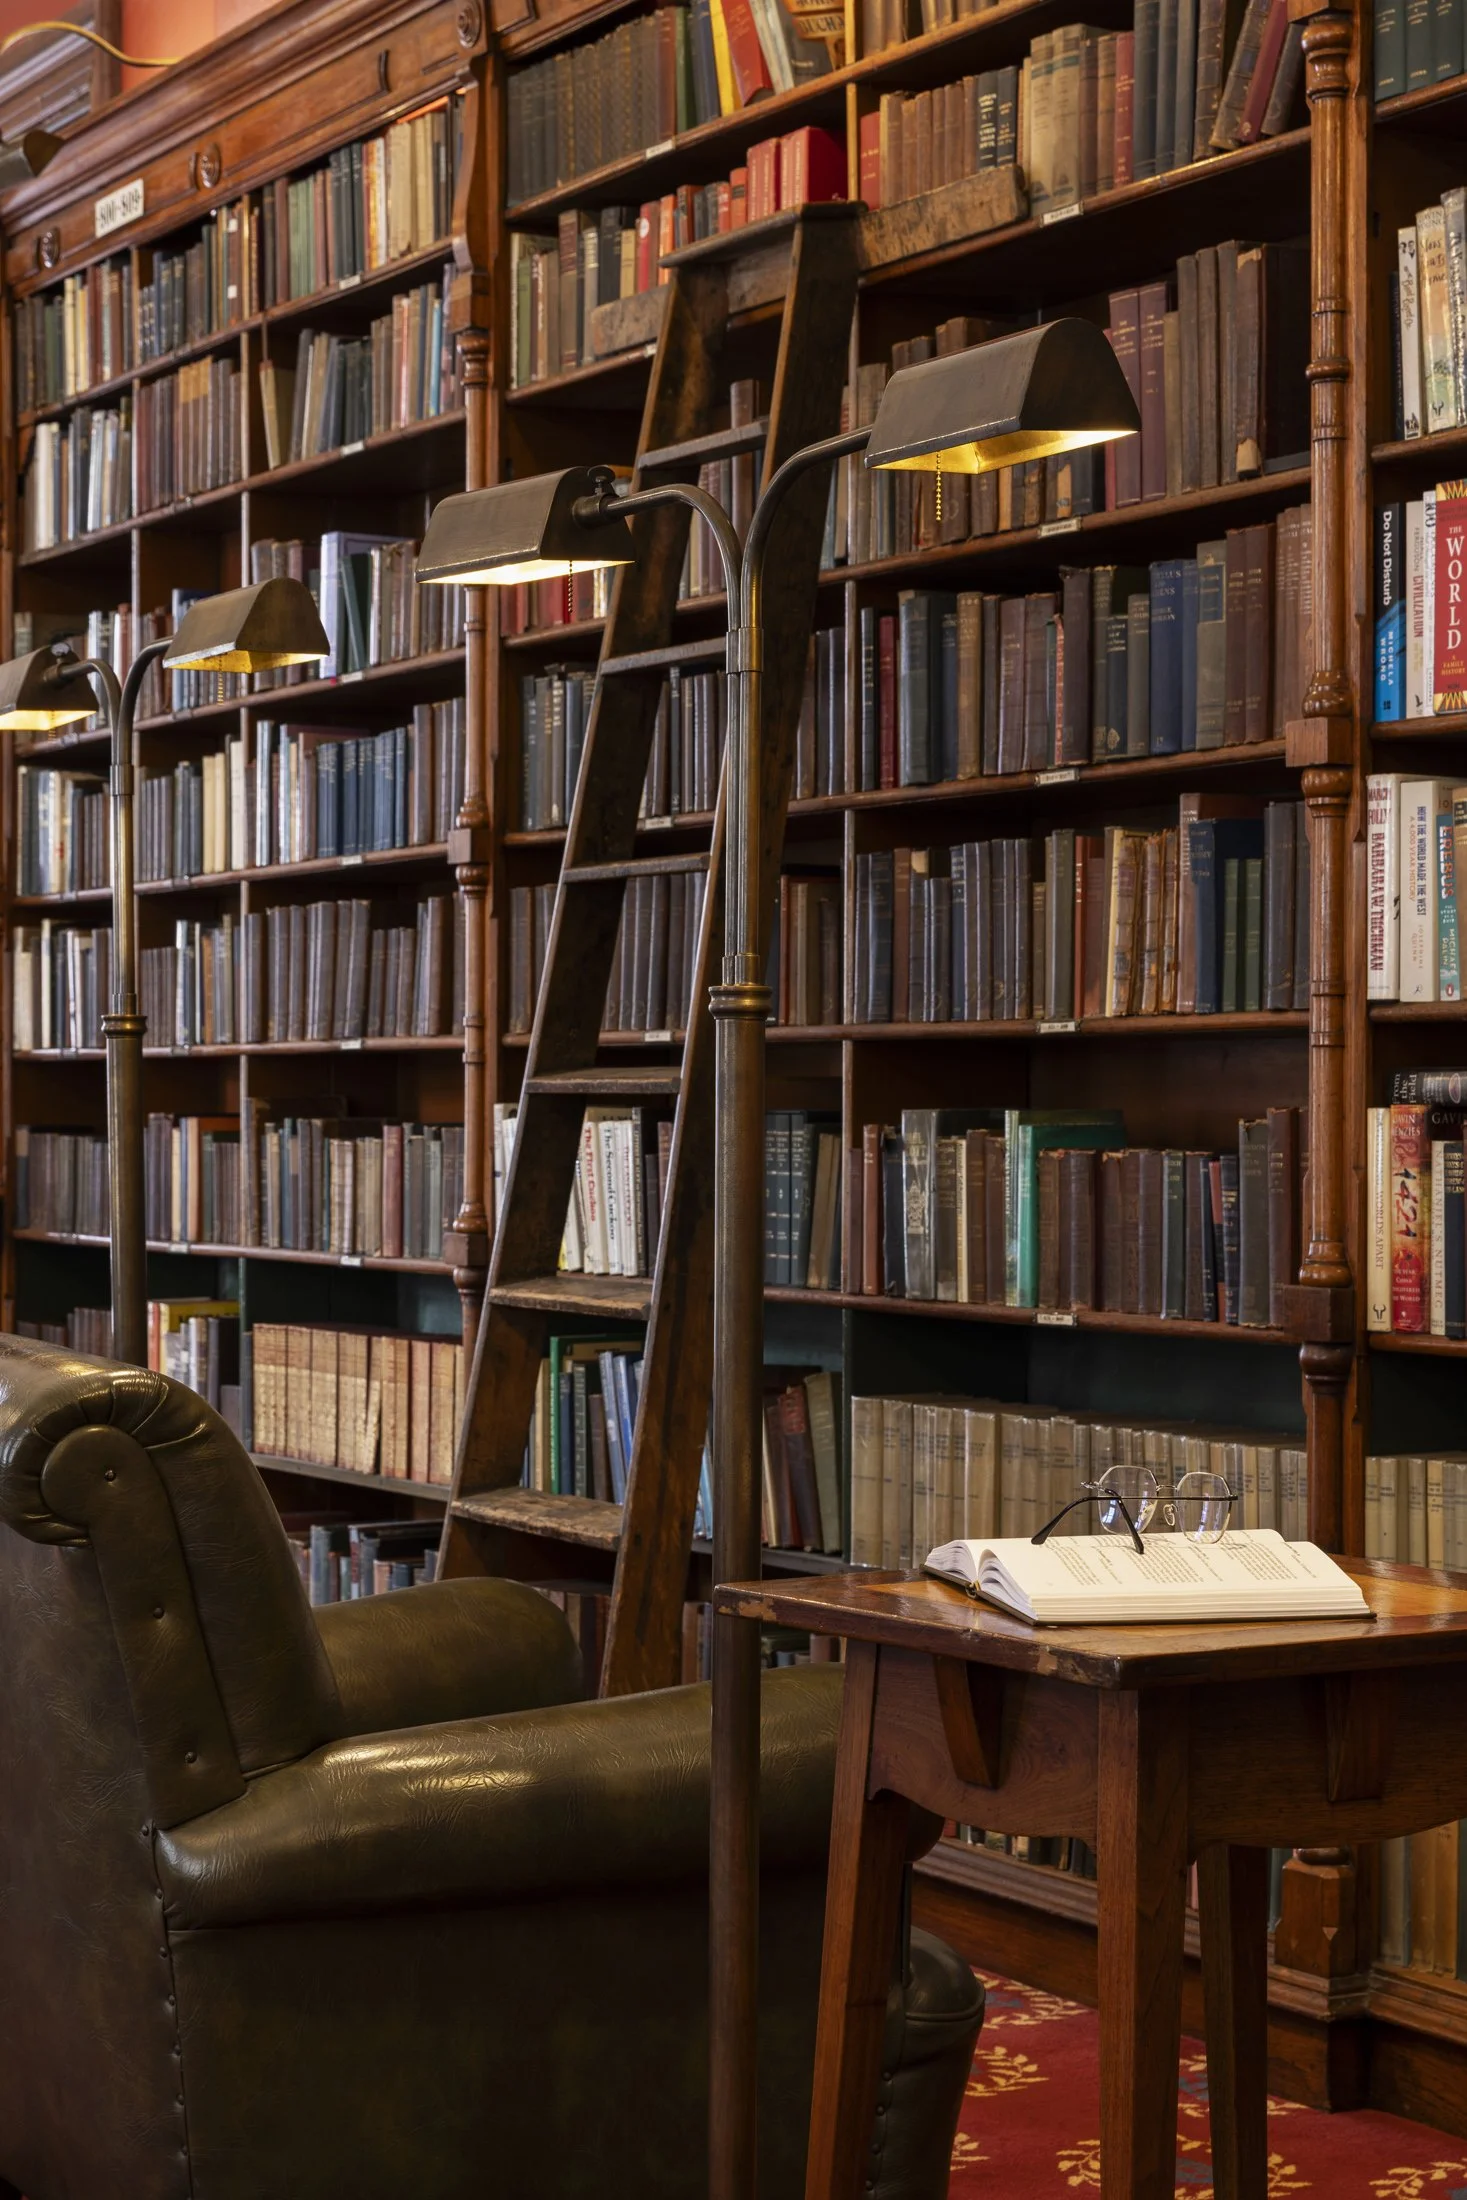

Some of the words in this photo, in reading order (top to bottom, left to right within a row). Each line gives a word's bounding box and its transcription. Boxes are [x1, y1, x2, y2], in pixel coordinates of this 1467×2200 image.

[1383, 510, 1392, 531] Do
[1449, 526, 1462, 535] THE
[1383, 532, 1392, 556] Not
[1383, 557, 1392, 606] Disturb
[1446, 536, 1465, 650] WORLD
[1413, 575, 1424, 638] CIVILIZATION
[1441, 668, 1466, 676] HISTORY
[1443, 660, 1464, 669] FAMILY
[1417, 806, 1427, 822] HOW
[1417, 824, 1427, 836] THE
[1417, 838, 1427, 861] WORLD
[1371, 832, 1385, 893] BARBARA
[1417, 863, 1427, 882] MADE
[1439, 825, 1455, 899] EREBUS
[1417, 884, 1427, 896] THE
[1417, 897, 1427, 916] WEST
[1370, 909, 1384, 971] TUCHMAN
[1400, 1080, 1409, 1098] the
[1408, 1074, 1418, 1104] Field
[1431, 1112, 1464, 1124] GAVI
[583, 1128, 593, 1149] The
[603, 1128, 614, 1150] The
[585, 1151, 595, 1177] First
[604, 1151, 616, 1193] Second
[587, 1180, 597, 1222] Cuckoo
[1393, 1168, 1418, 1238] 1421
[607, 1195, 617, 1240] Cuckoo
[1375, 1191, 1384, 1236] WORLDS
[1375, 1236, 1384, 1270] APART
